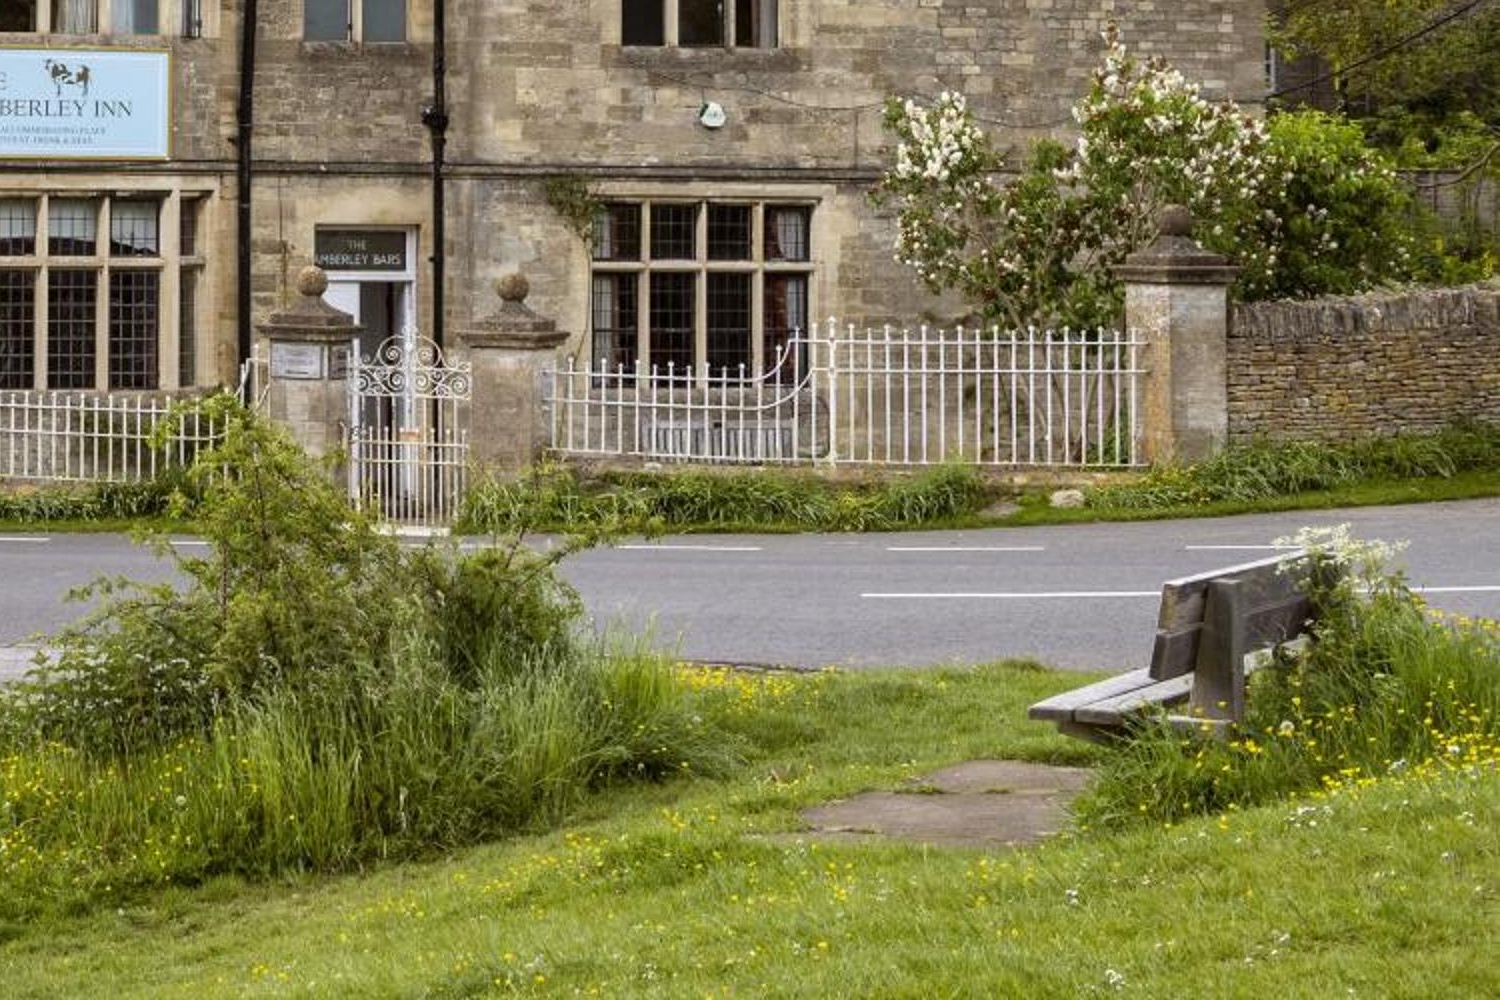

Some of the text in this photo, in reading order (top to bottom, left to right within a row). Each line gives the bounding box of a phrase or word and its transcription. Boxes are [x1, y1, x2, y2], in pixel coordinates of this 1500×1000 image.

[94, 100, 133, 118] INN
[347, 239, 367, 250] THE
[373, 253, 402, 265] BARS
